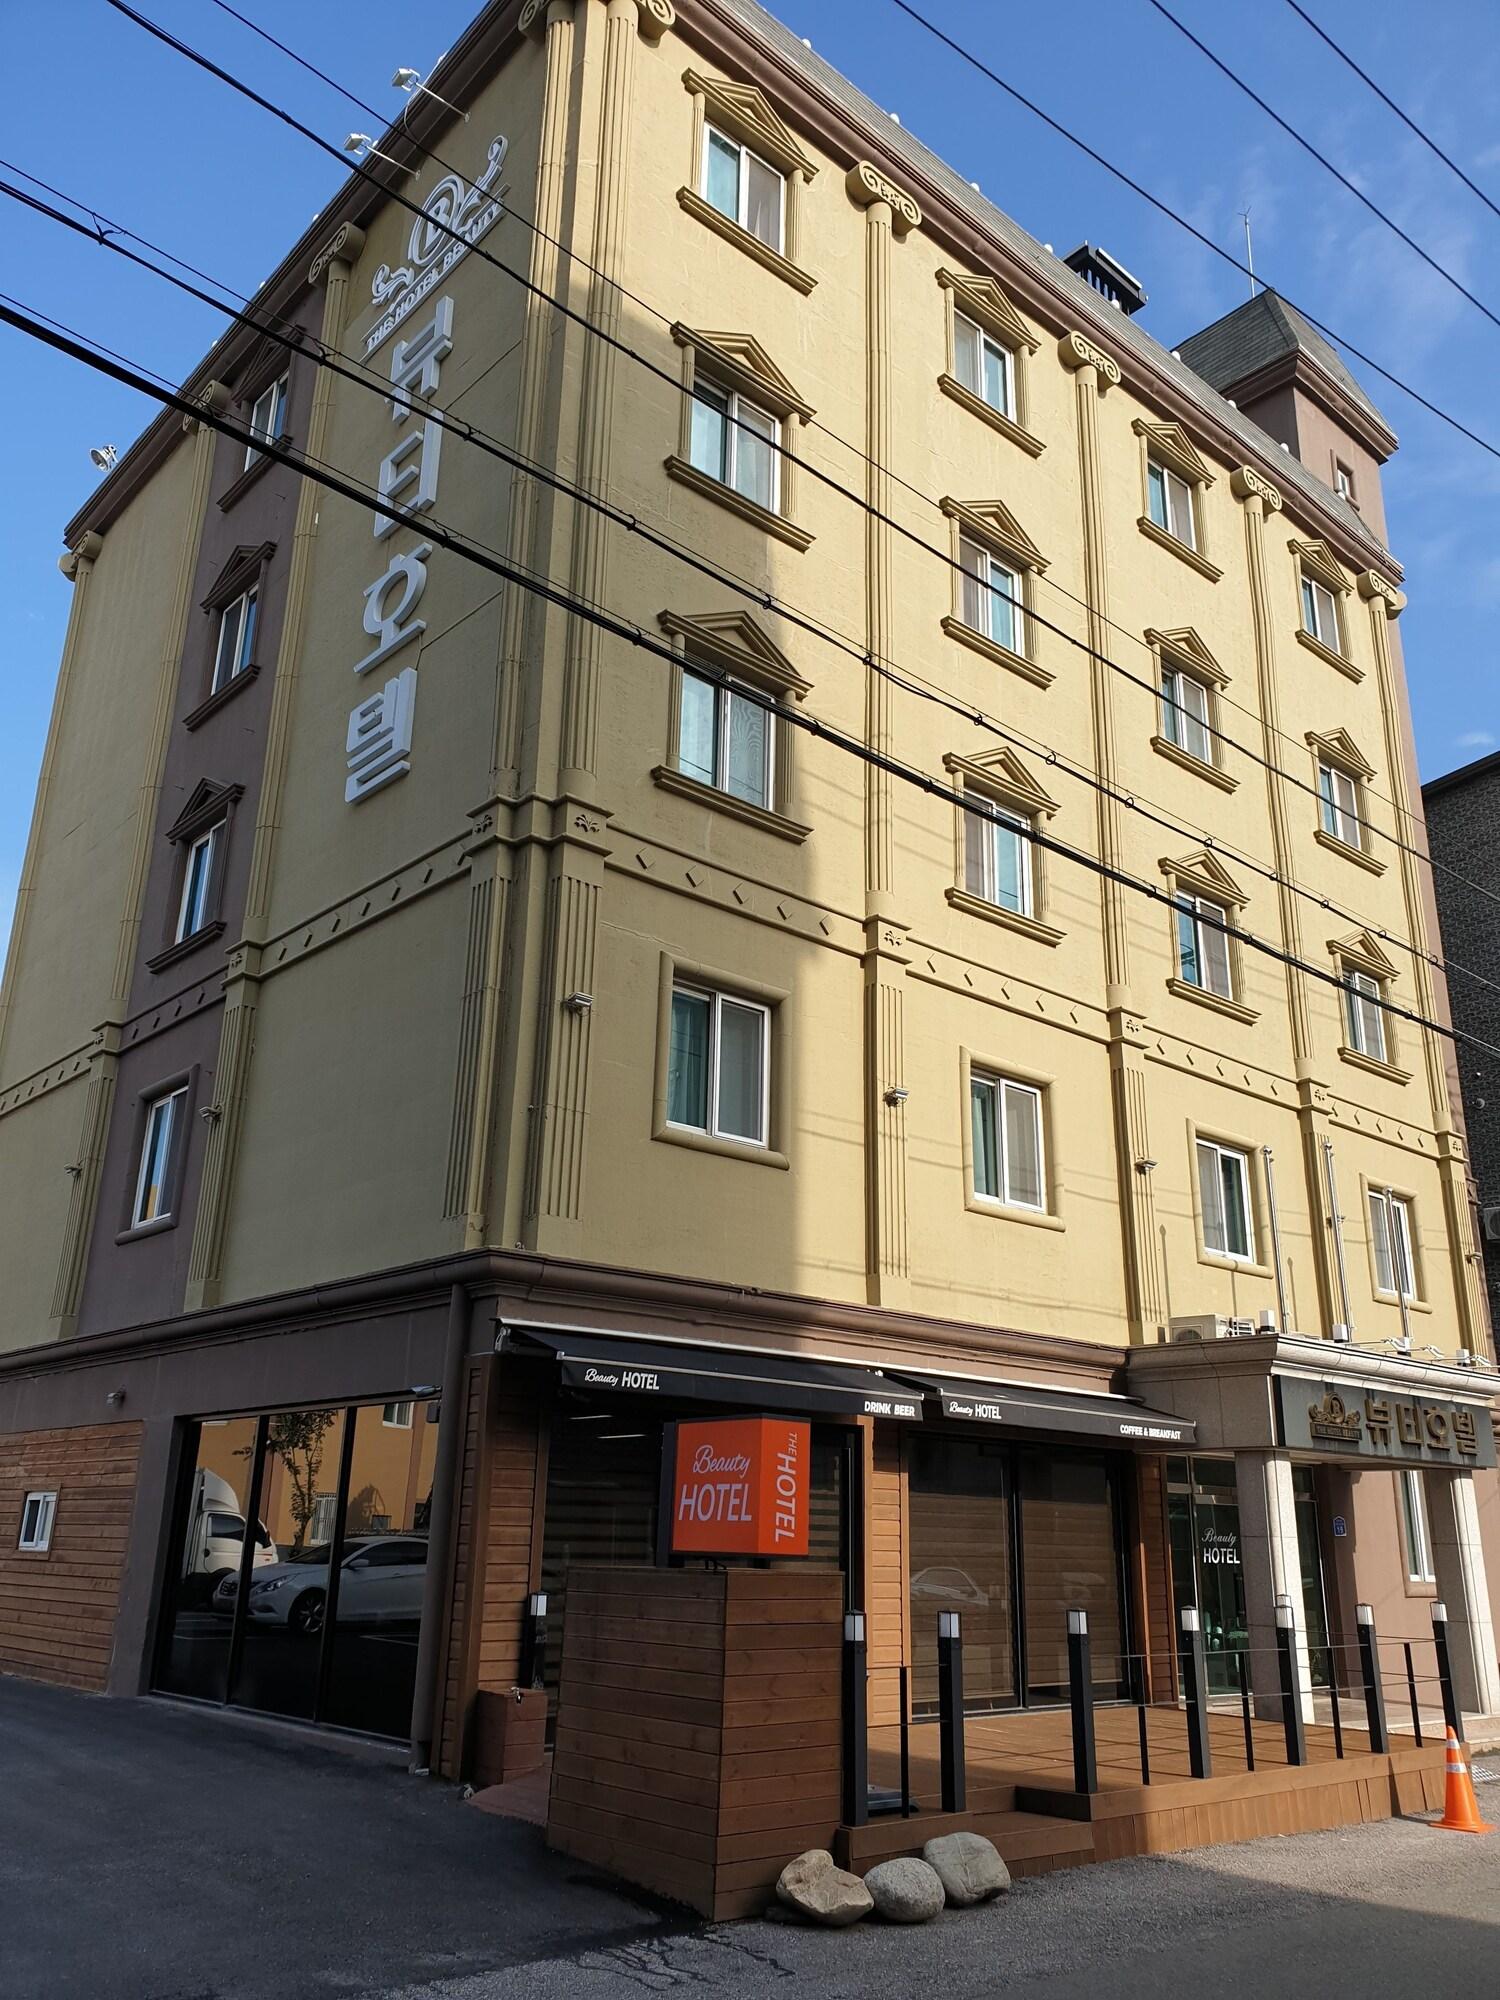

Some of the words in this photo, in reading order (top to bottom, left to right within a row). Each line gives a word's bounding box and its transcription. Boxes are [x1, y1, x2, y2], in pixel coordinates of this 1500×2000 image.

[366, 315, 396, 352] THE
[394, 267, 441, 325] HOTEL
[344, 295, 455, 804] 뷰티호텔
[584, 1368, 619, 1387] Beauty
[621, 1371, 660, 1390] HOTEL
[864, 1400, 892, 1415] DRINK
[893, 1404, 916, 1417] BEER
[949, 1401, 973, 1416] Beauty
[974, 1403, 1002, 1420] HOTEL
[1120, 1424, 1143, 1436] COFFEE
[1143, 1427, 1149, 1437] &
[1148, 1427, 1181, 1440] BREAKFAST
[1364, 1397, 1480, 1457] 뷰티호텔
[788, 1431, 798, 1456] THE
[692, 1444, 752, 1479] Beauty
[678, 1483, 753, 1521] HOTEL
[774, 1452, 797, 1543] HOTEL
[1201, 1527, 1237, 1548] Beauty
[1203, 1547, 1241, 1564] HOTEL
